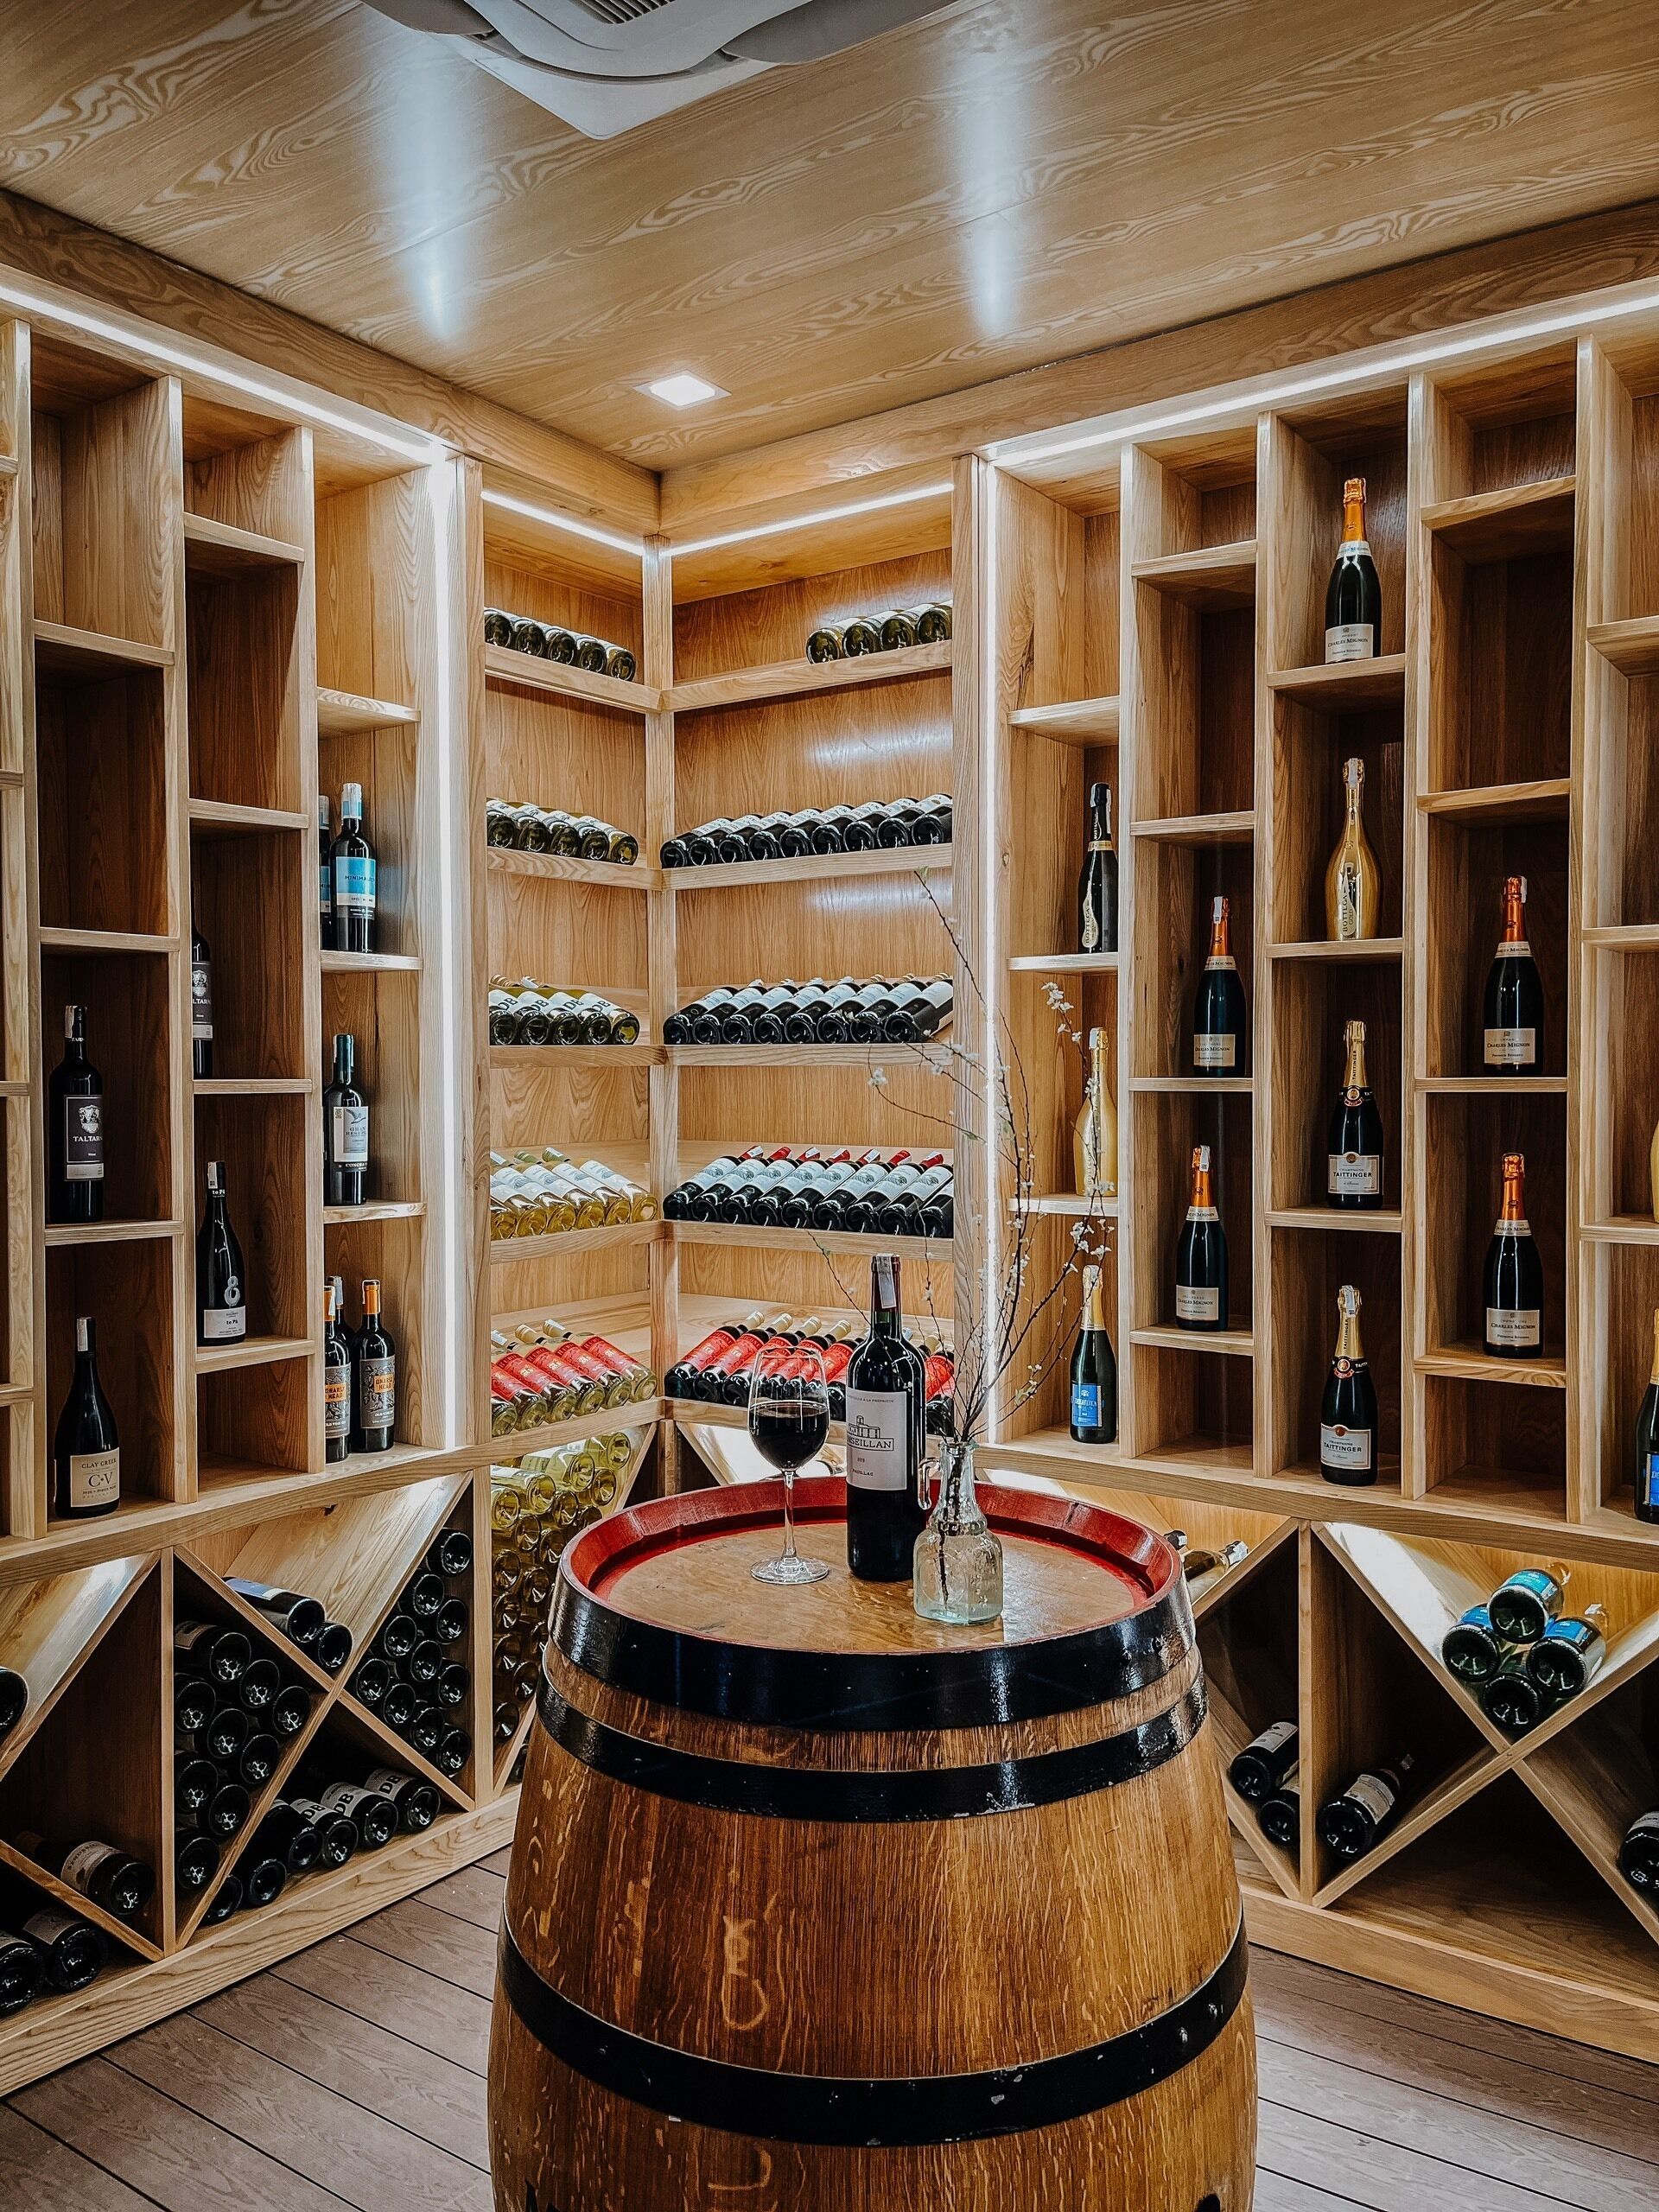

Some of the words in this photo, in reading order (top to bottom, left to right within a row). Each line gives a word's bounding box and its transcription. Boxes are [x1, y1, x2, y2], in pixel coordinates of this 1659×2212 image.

[563, 999, 584, 1011] DB
[1324, 1442, 1362, 1452] TAITTINGER
[379, 1774, 402, 1794] DB
[303, 1804, 326, 1820] DB
[333, 1793, 354, 1815] DB
